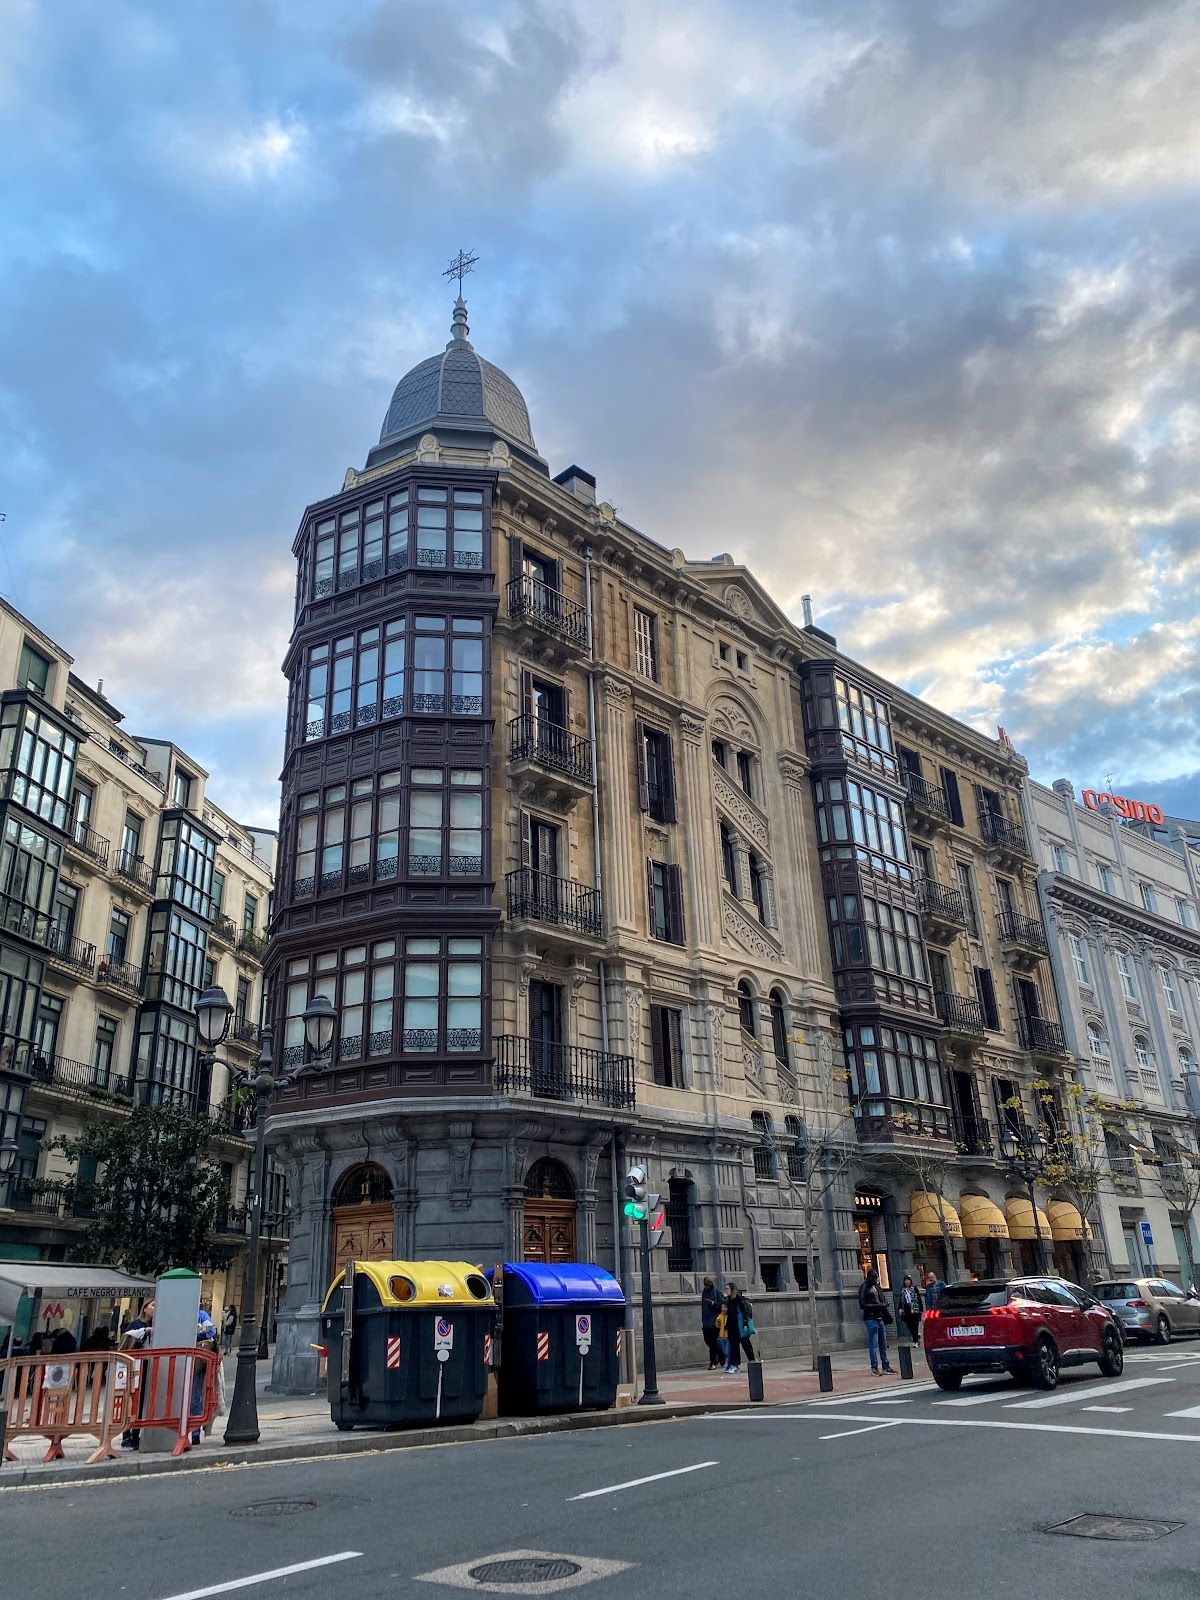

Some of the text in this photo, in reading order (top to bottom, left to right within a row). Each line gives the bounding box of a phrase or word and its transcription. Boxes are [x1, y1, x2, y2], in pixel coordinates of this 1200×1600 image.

[90, 1287, 116, 1297] NEGRO
[117, 1287, 122, 1296] Y
[124, 1288, 151, 1297] BLANCO
